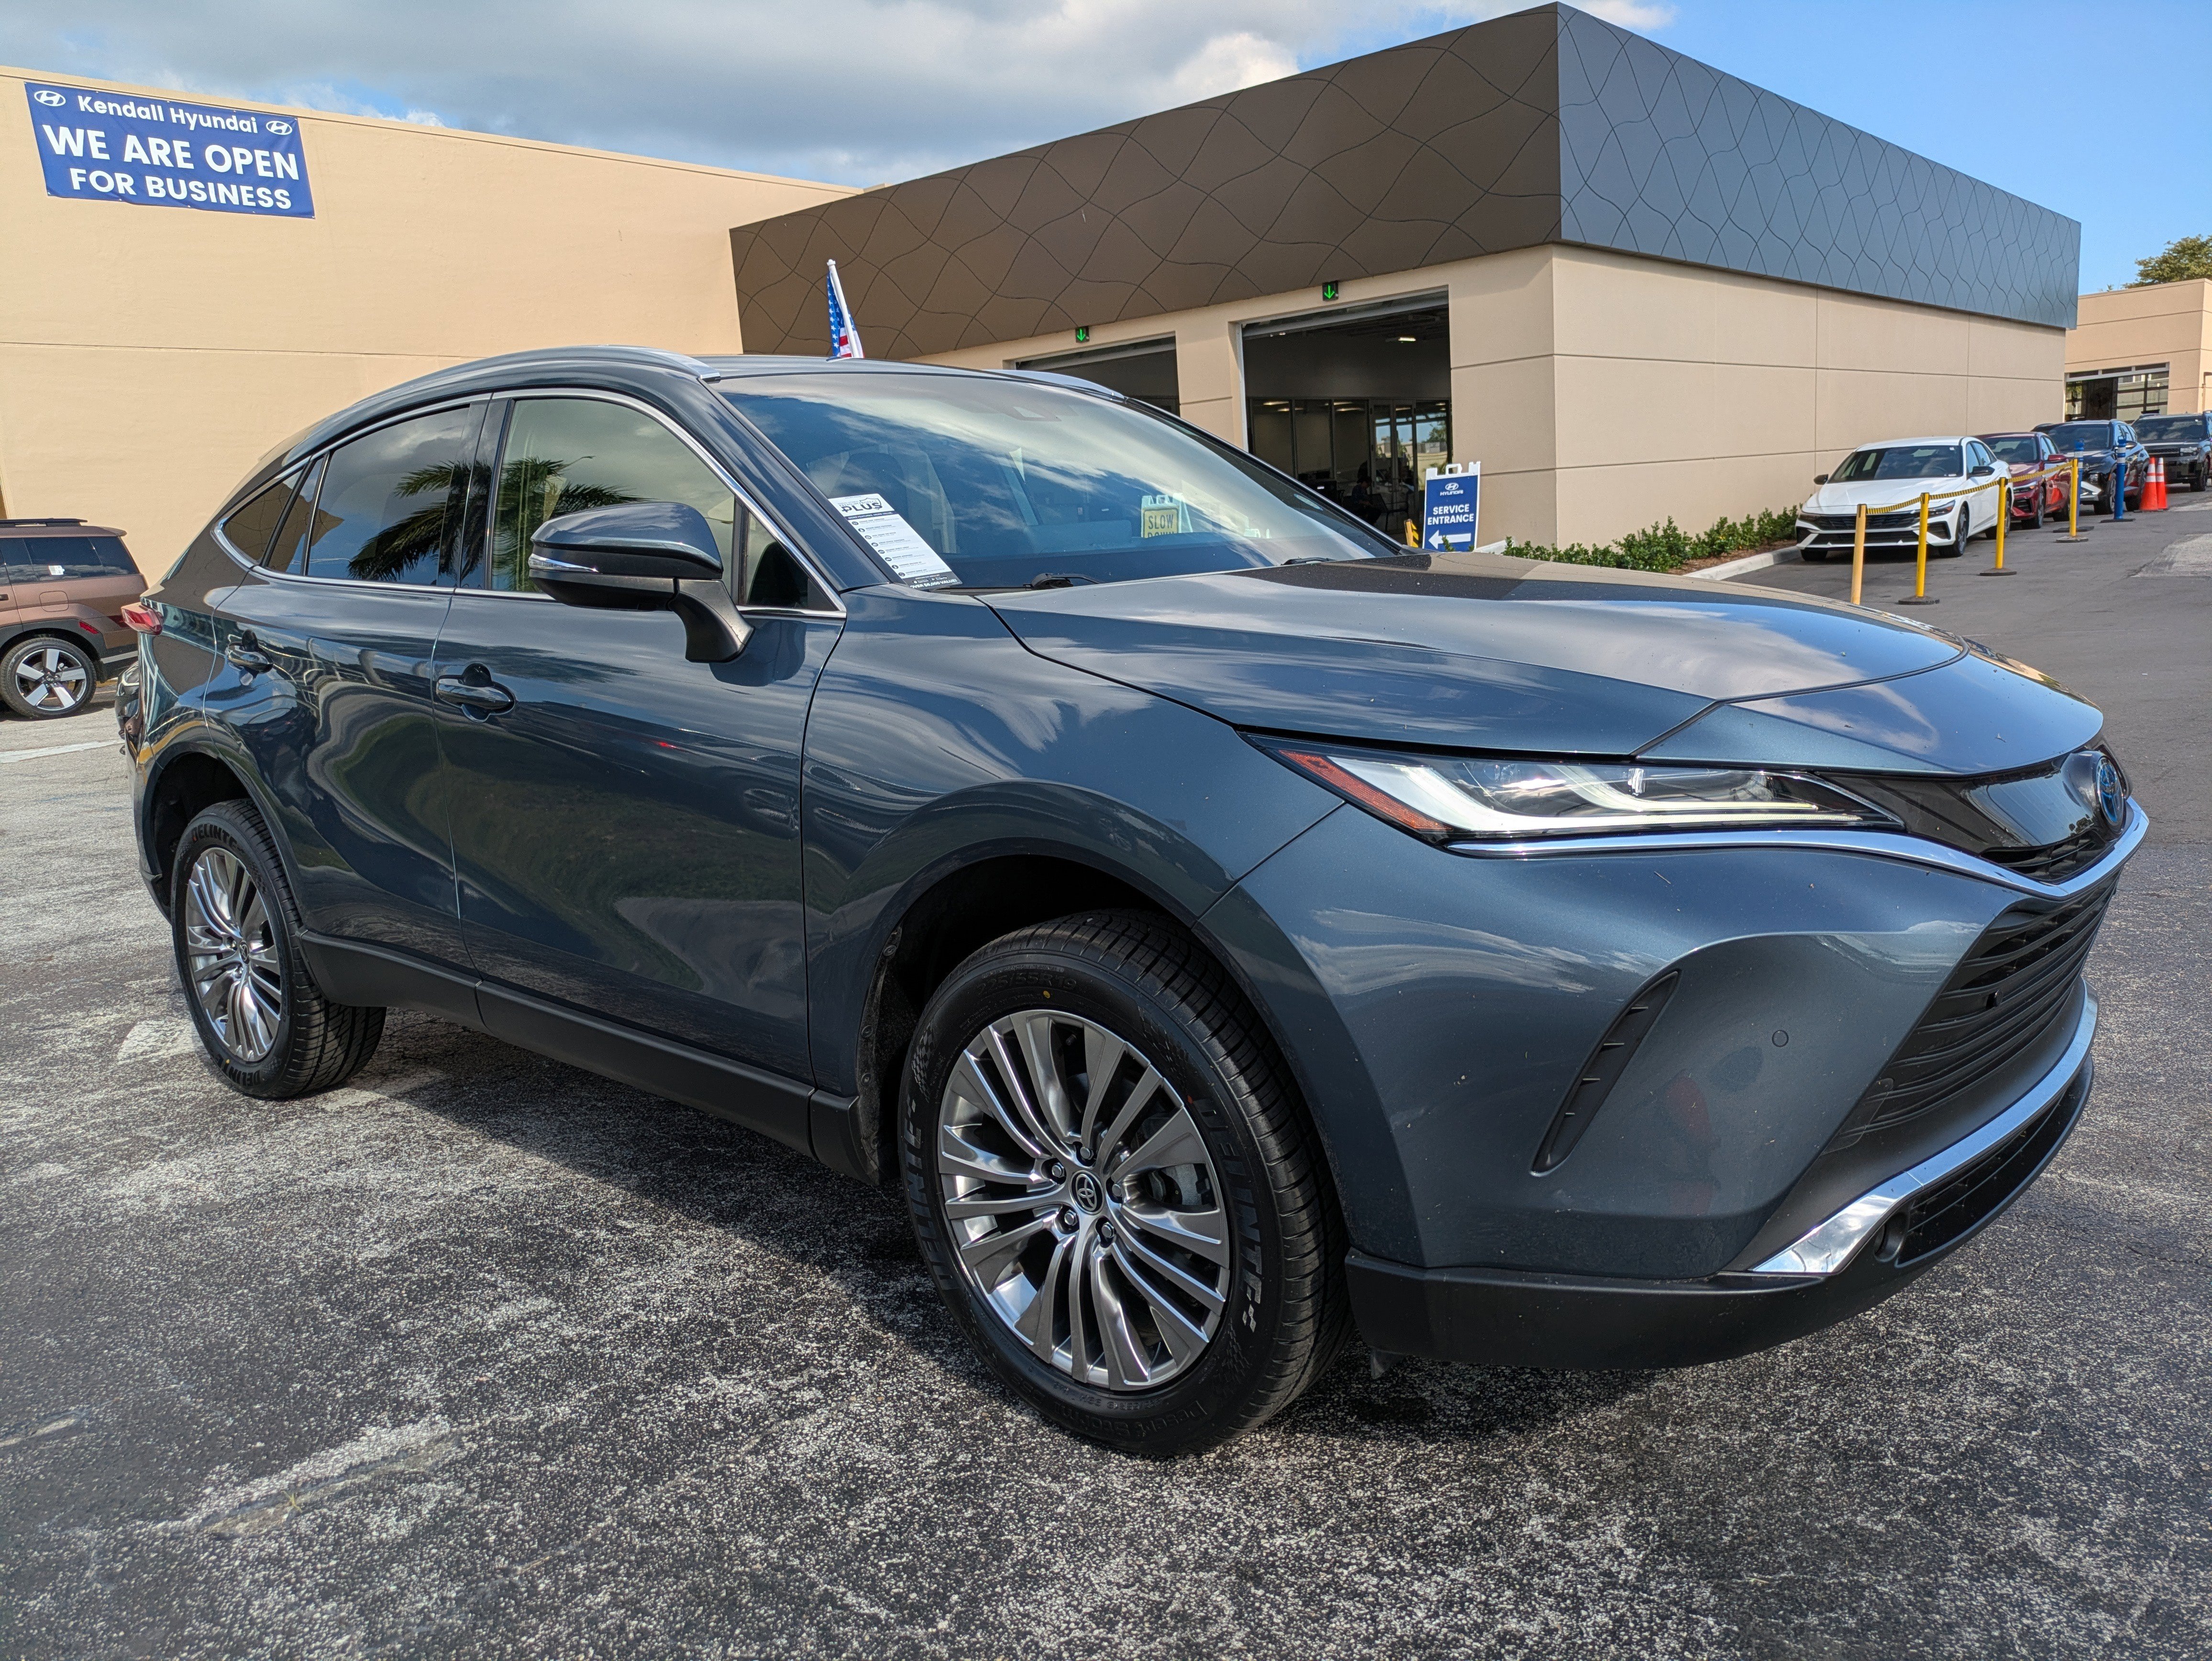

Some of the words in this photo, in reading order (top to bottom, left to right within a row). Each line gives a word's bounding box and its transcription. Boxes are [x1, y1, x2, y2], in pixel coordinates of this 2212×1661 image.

[77, 95, 165, 122] Kendall
[170, 108, 258, 134] Hyundai
[43, 124, 110, 160] WE
[123, 134, 194, 169] ARE
[205, 144, 299, 180] OPEN
[69, 168, 137, 196] FOR
[145, 175, 291, 209] BUSINESS
[841, 502, 883, 513] PLUS
[1148, 514, 1173, 529] SLOW
[1427, 513, 1474, 525] ENTRANCE
[1433, 503, 1470, 515] SERVICE
[191, 823, 238, 846] DELINTE
[903, 1118, 960, 1291] DELINTE
[1193, 1097, 1262, 1305] DELINTE
